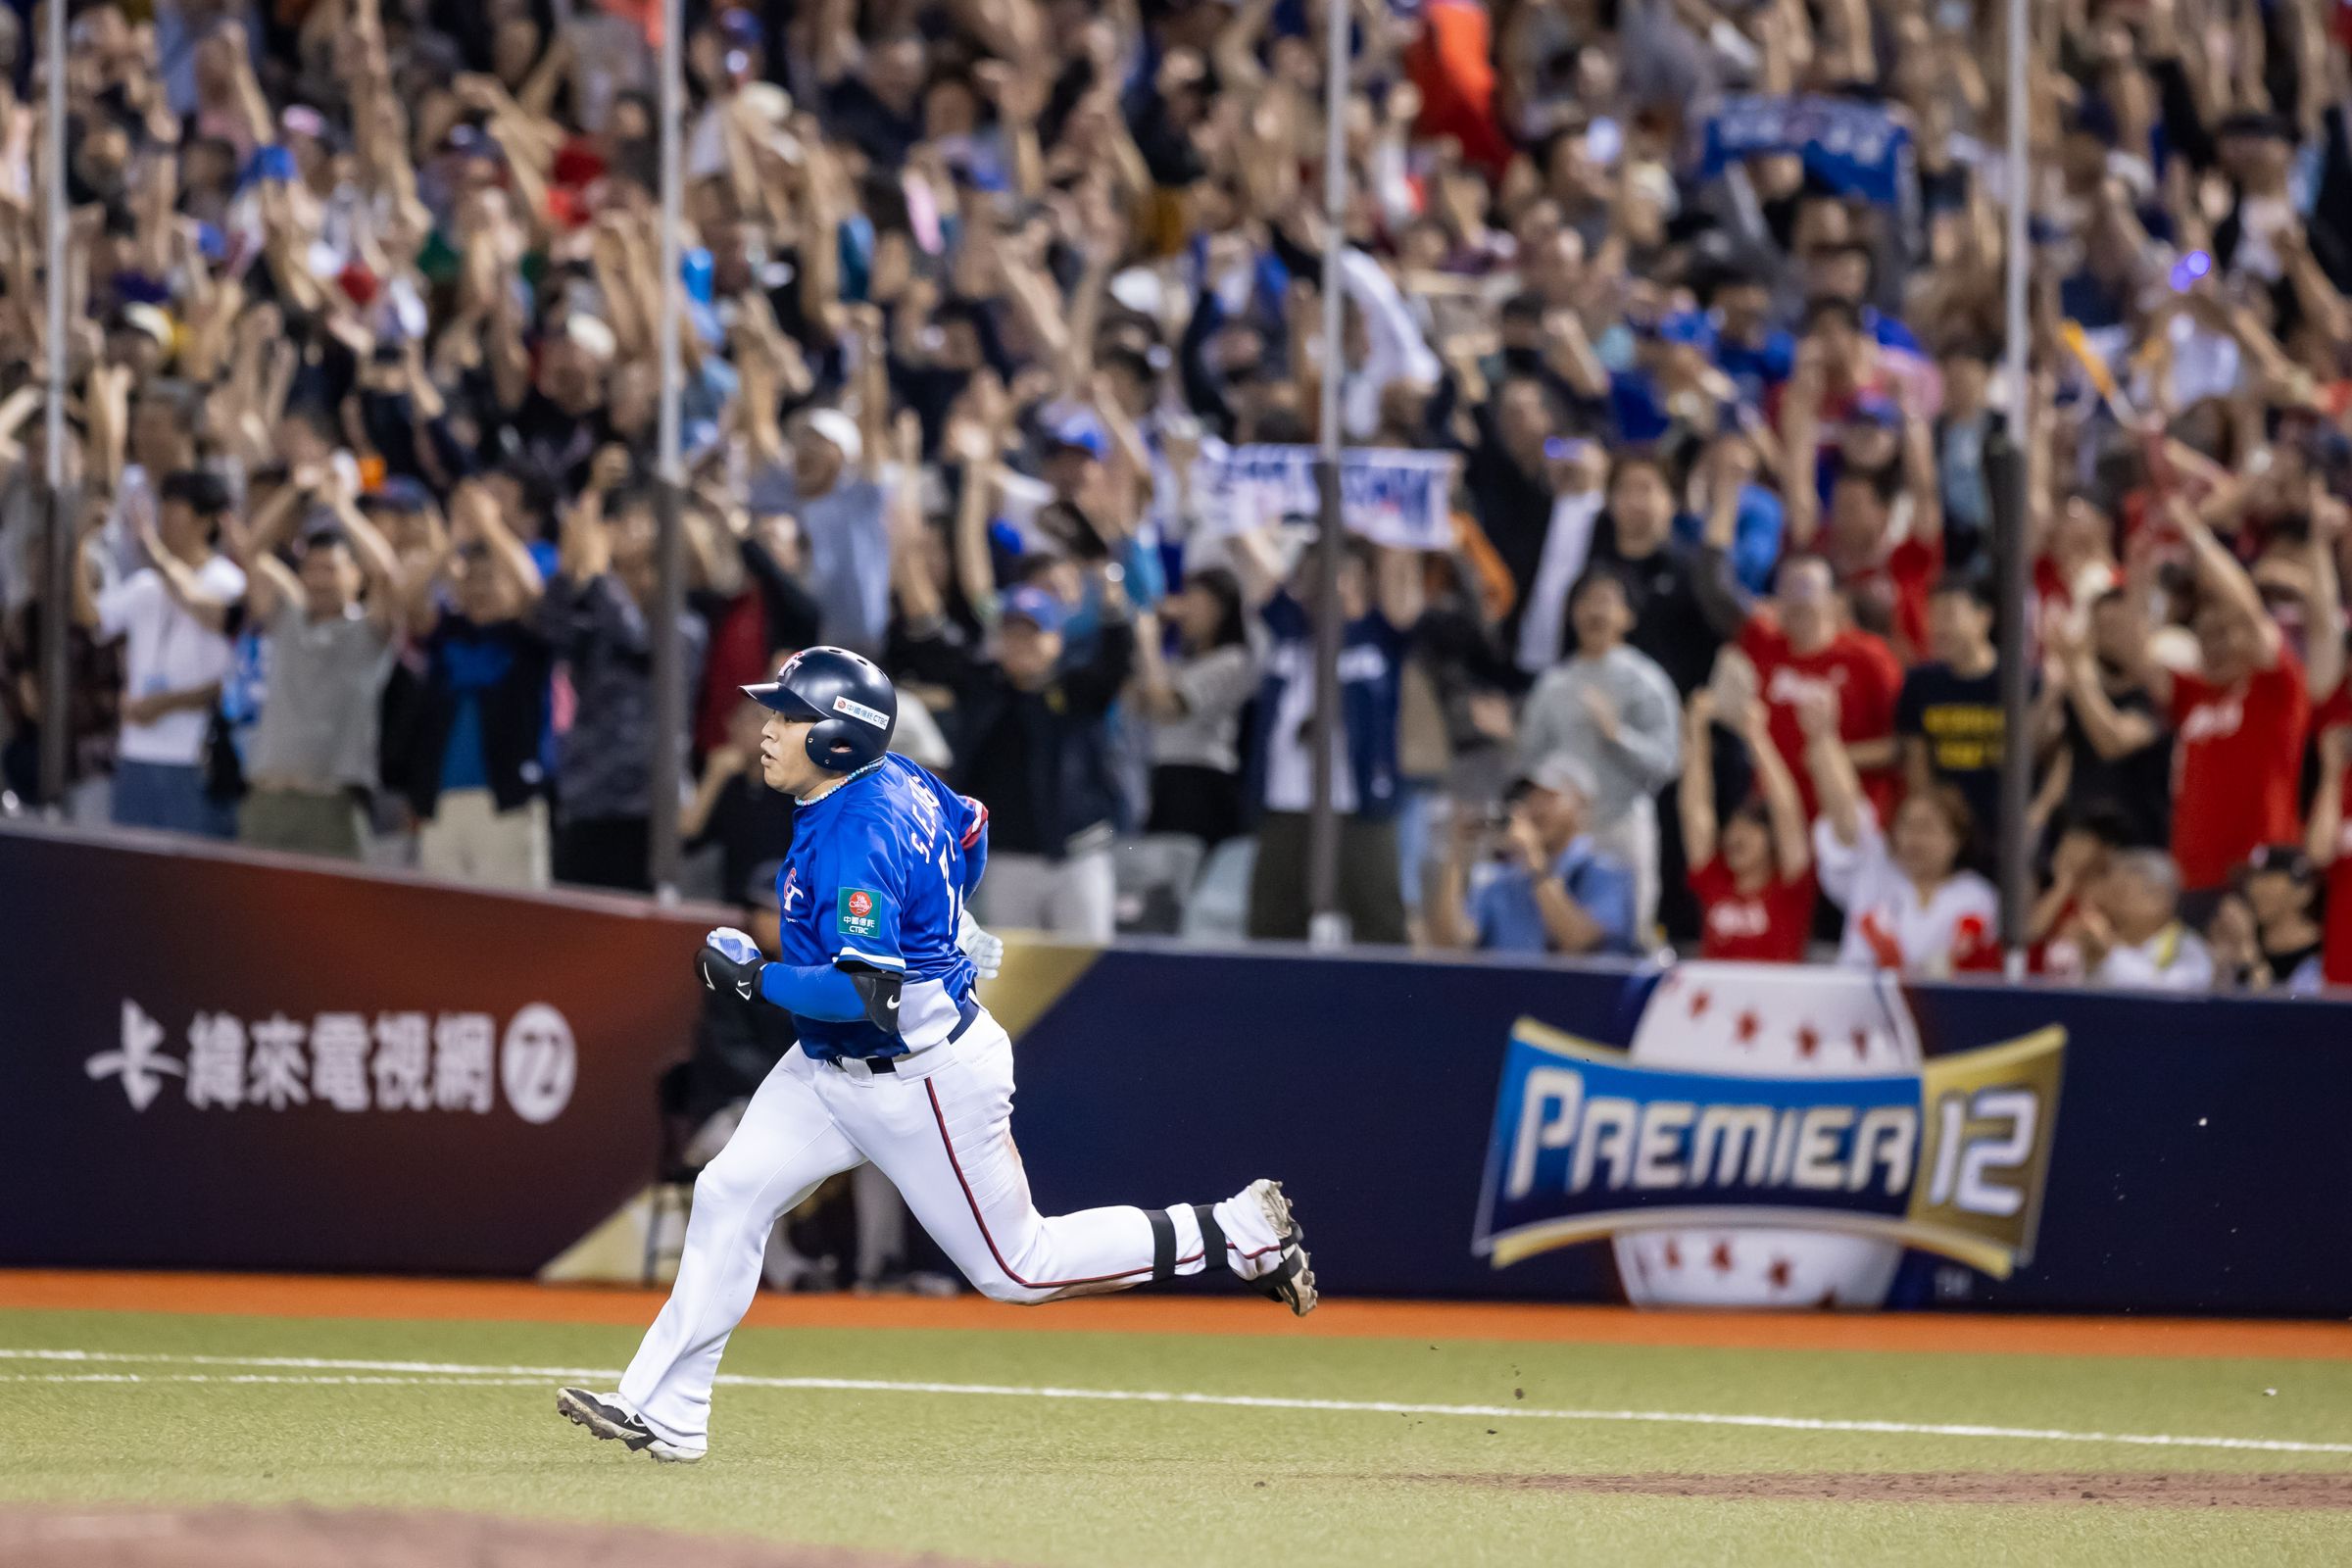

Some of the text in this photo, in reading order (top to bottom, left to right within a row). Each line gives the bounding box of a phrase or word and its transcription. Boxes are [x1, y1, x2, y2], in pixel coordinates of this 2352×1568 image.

[872, 714, 888, 726] CTBC
[849, 925, 869, 935] CTBC
[186, 1008, 494, 1114] 緯來電視網
[1502, 1066, 2039, 1217] PREMIER 12
